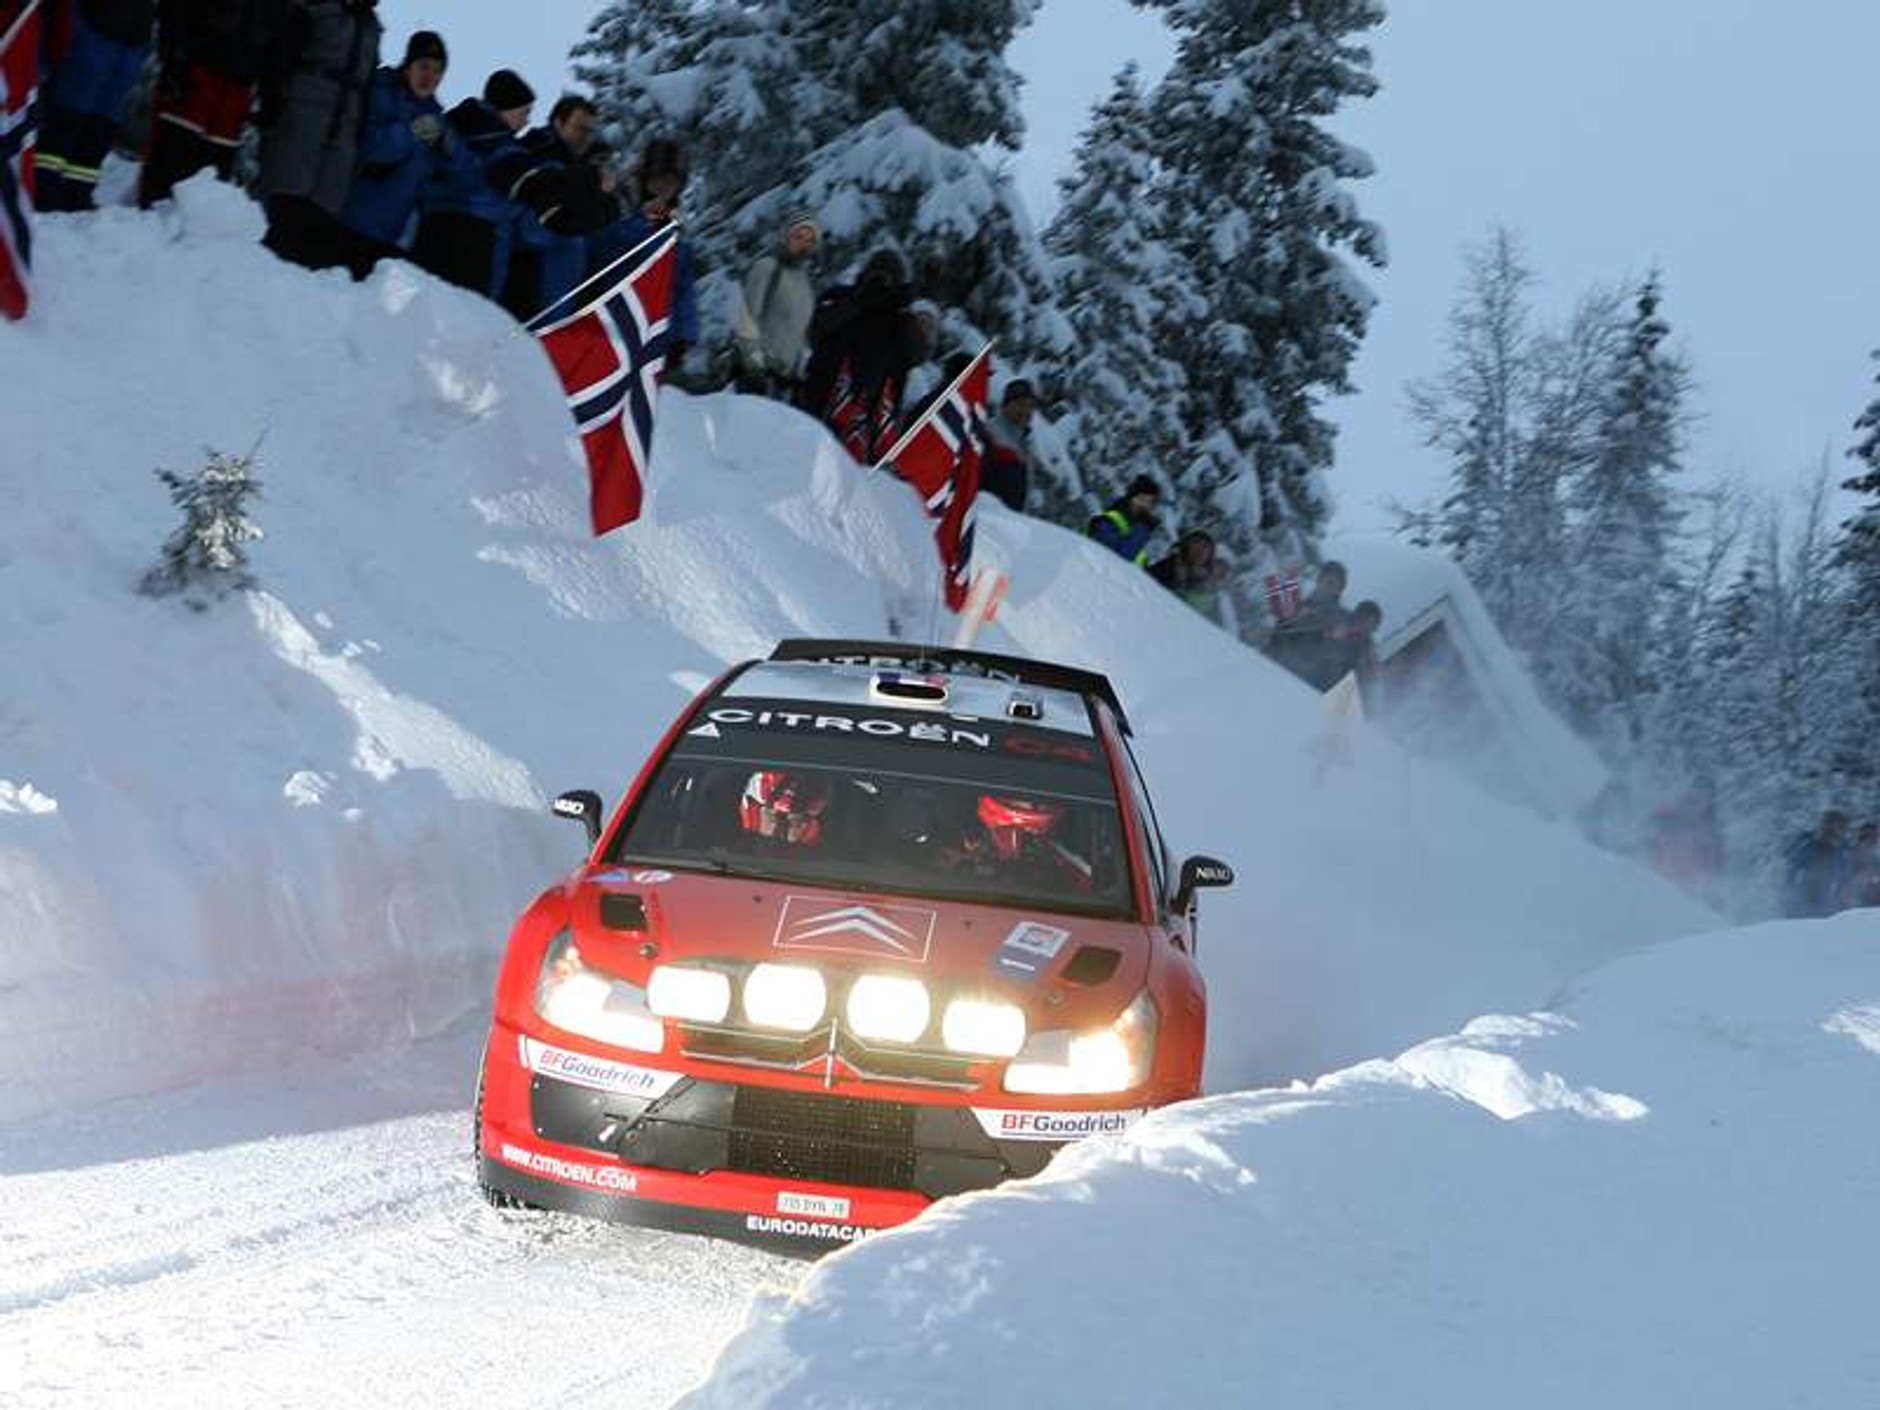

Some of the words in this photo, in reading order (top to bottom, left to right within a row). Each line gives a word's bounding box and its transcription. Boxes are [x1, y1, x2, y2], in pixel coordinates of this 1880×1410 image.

[708, 709, 989, 747] CITROËN
[540, 1050, 656, 1089] BFGoodrich
[1001, 1113, 1127, 1133] BFGoodrich
[502, 1143, 638, 1190] WWW.CITROEN.COM
